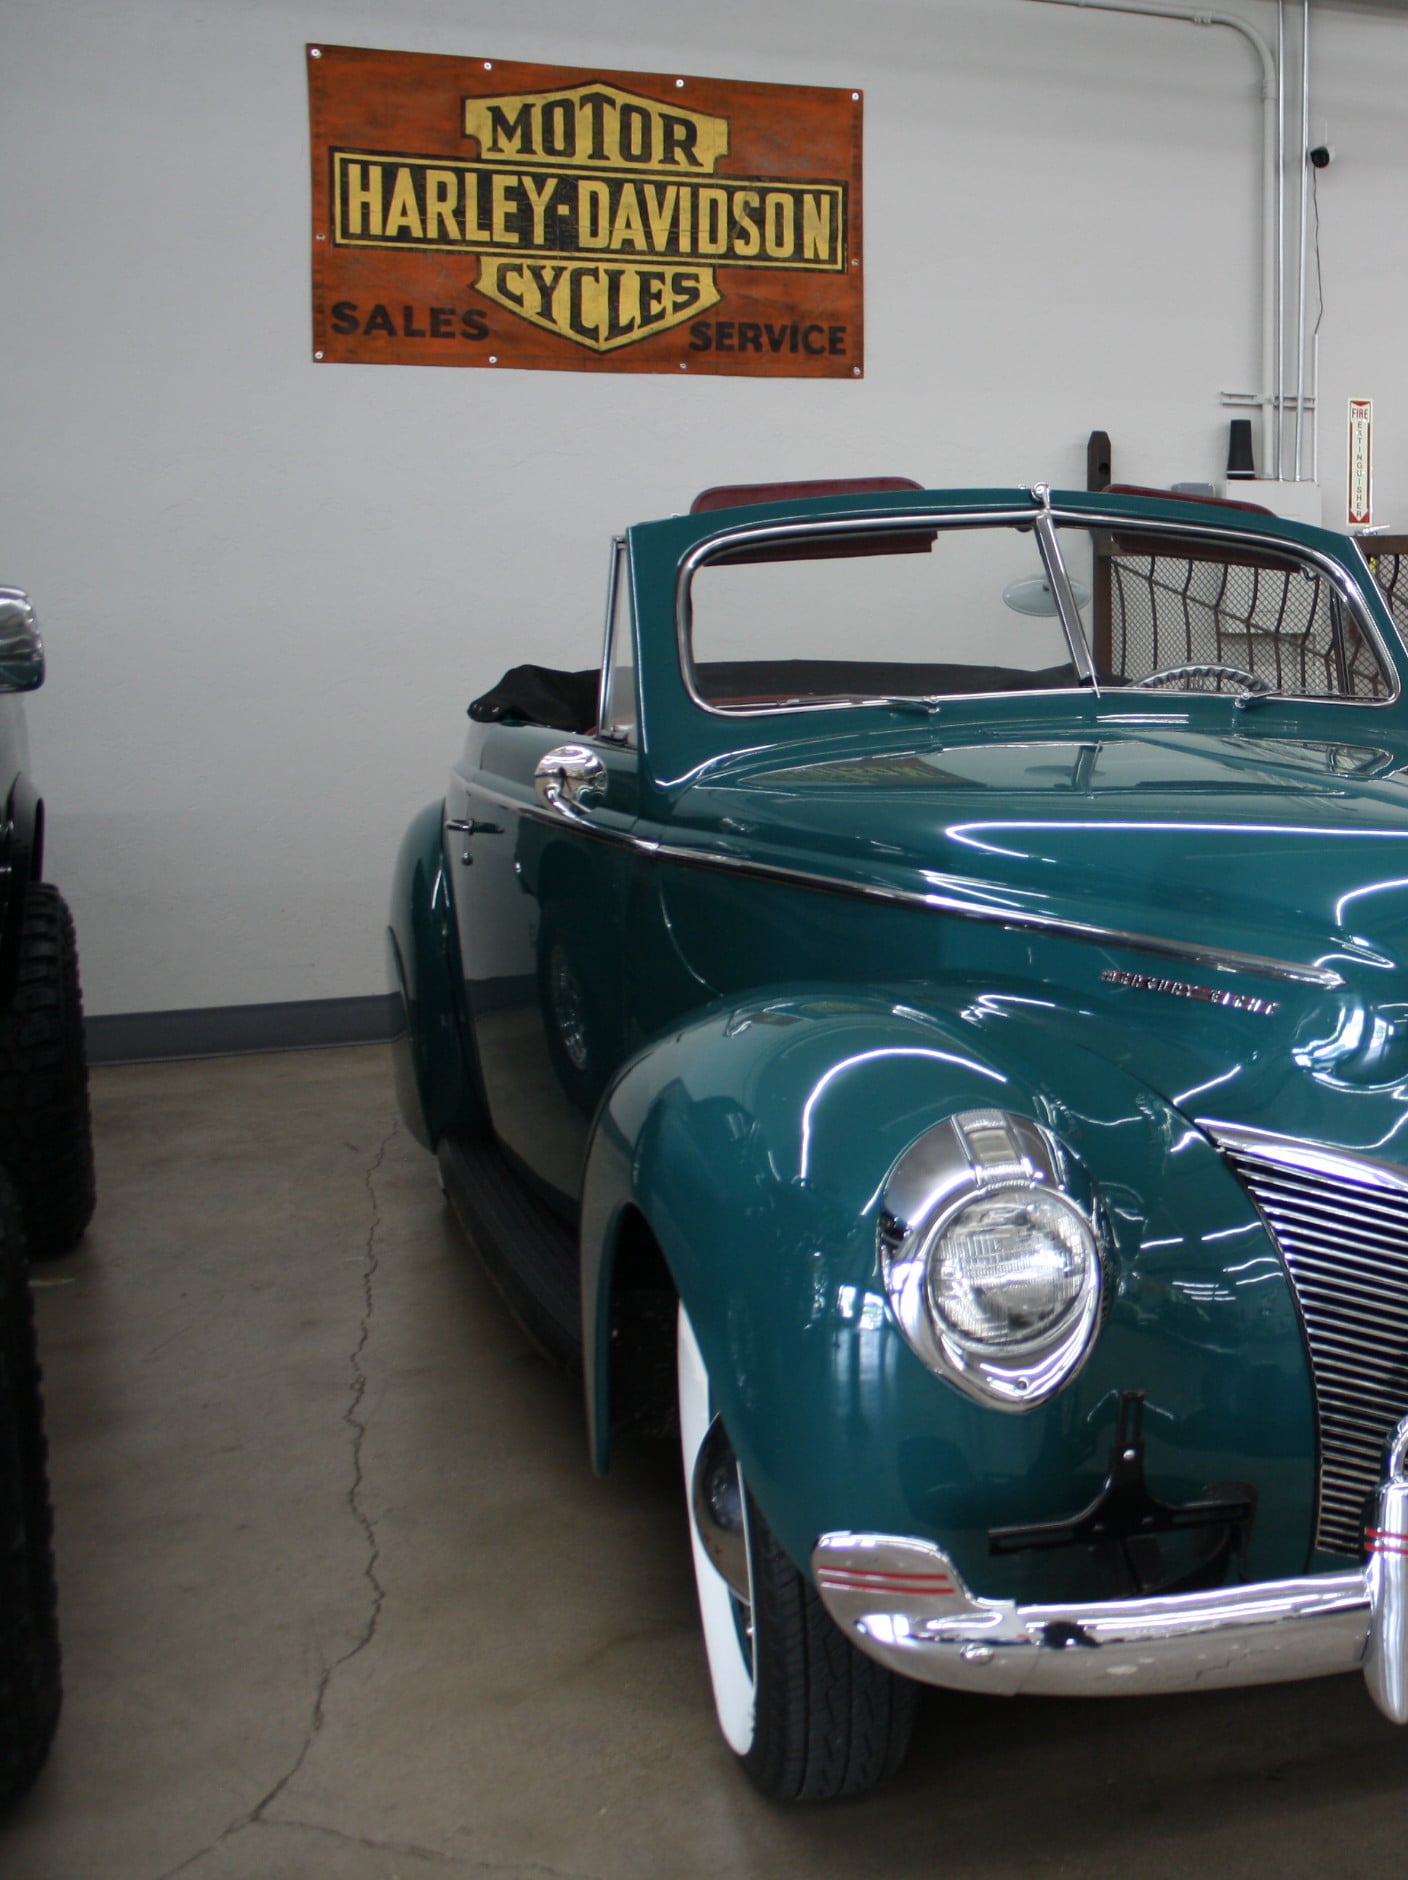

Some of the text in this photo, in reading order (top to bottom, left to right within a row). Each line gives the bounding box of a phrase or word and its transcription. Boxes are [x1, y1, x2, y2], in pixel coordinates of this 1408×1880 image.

[486, 92, 705, 167] MOTOR
[346, 163, 832, 261] HARLEY-DAVIDSON
[330, 301, 490, 342] SALES
[495, 262, 701, 342] CYCLES
[688, 319, 847, 356] SERVICE
[1351, 408, 1369, 420] FIRE
[1355, 421, 1363, 518] EXTINGUISHER
